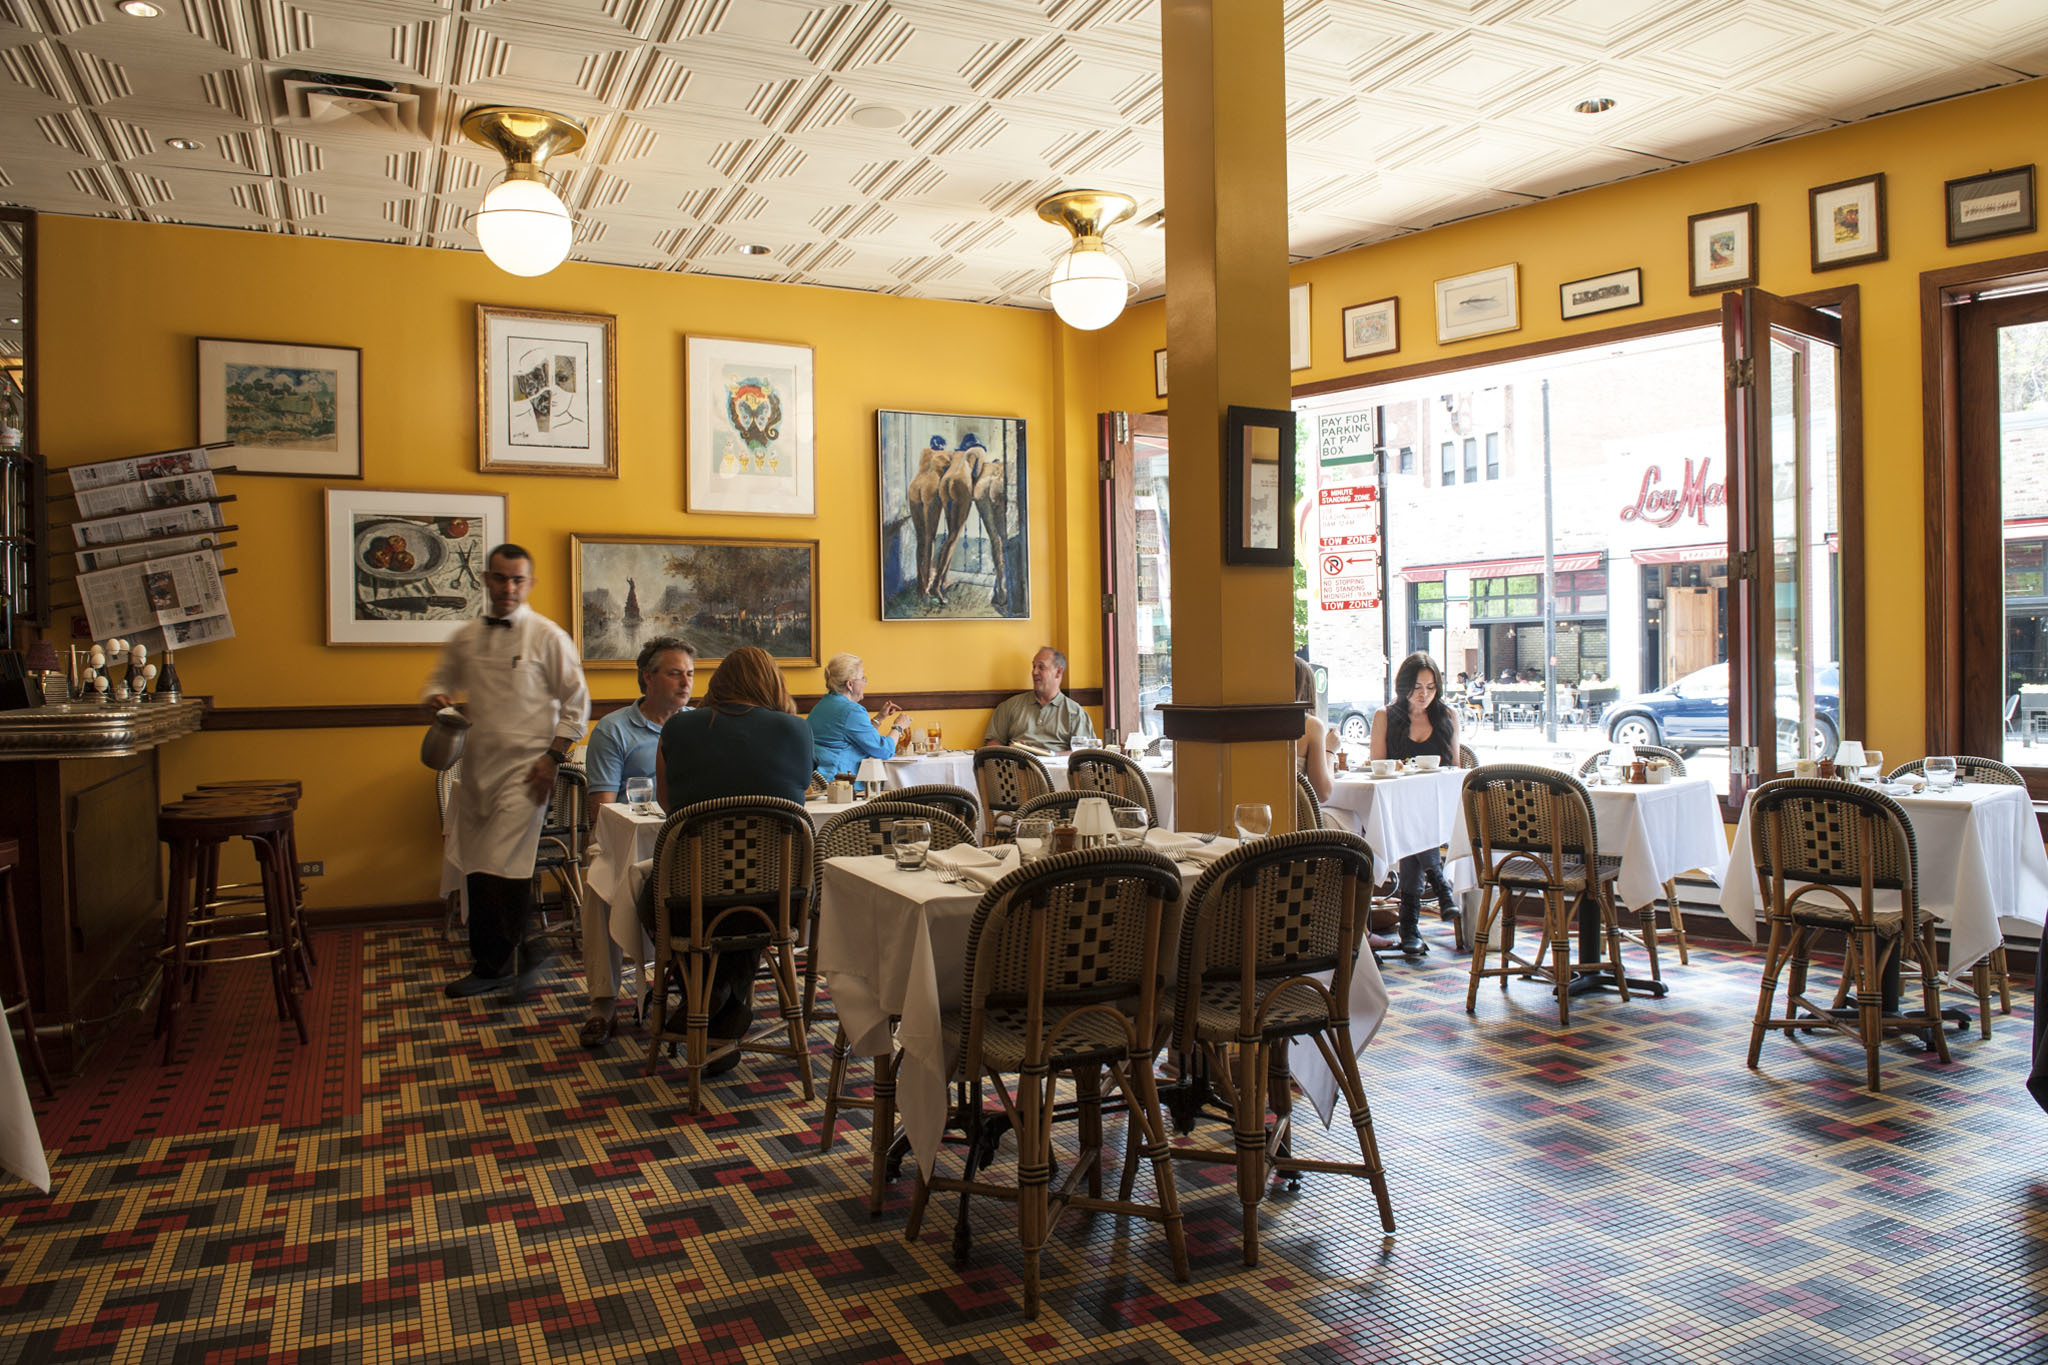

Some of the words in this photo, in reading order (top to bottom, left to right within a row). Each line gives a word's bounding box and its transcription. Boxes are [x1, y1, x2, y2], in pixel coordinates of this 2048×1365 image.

[1321, 417, 1341, 427] PAY
[1346, 413, 1367, 424] FOR
[1321, 423, 1371, 437] PARKING
[1323, 437, 1336, 447] AT
[1340, 433, 1361, 445] PAY
[1322, 445, 1344, 456] BOX
[1330, 488, 1353, 497] MINUTE
[1620, 465, 1678, 524] Lou
[1321, 495, 1352, 504] STANDING
[1353, 493, 1371, 502] ZONE
[1322, 537, 1342, 545] TOW
[1347, 535, 1372, 544] ZONE
[1325, 602, 1344, 610] TOW
[1348, 599, 1374, 609] ZONE
